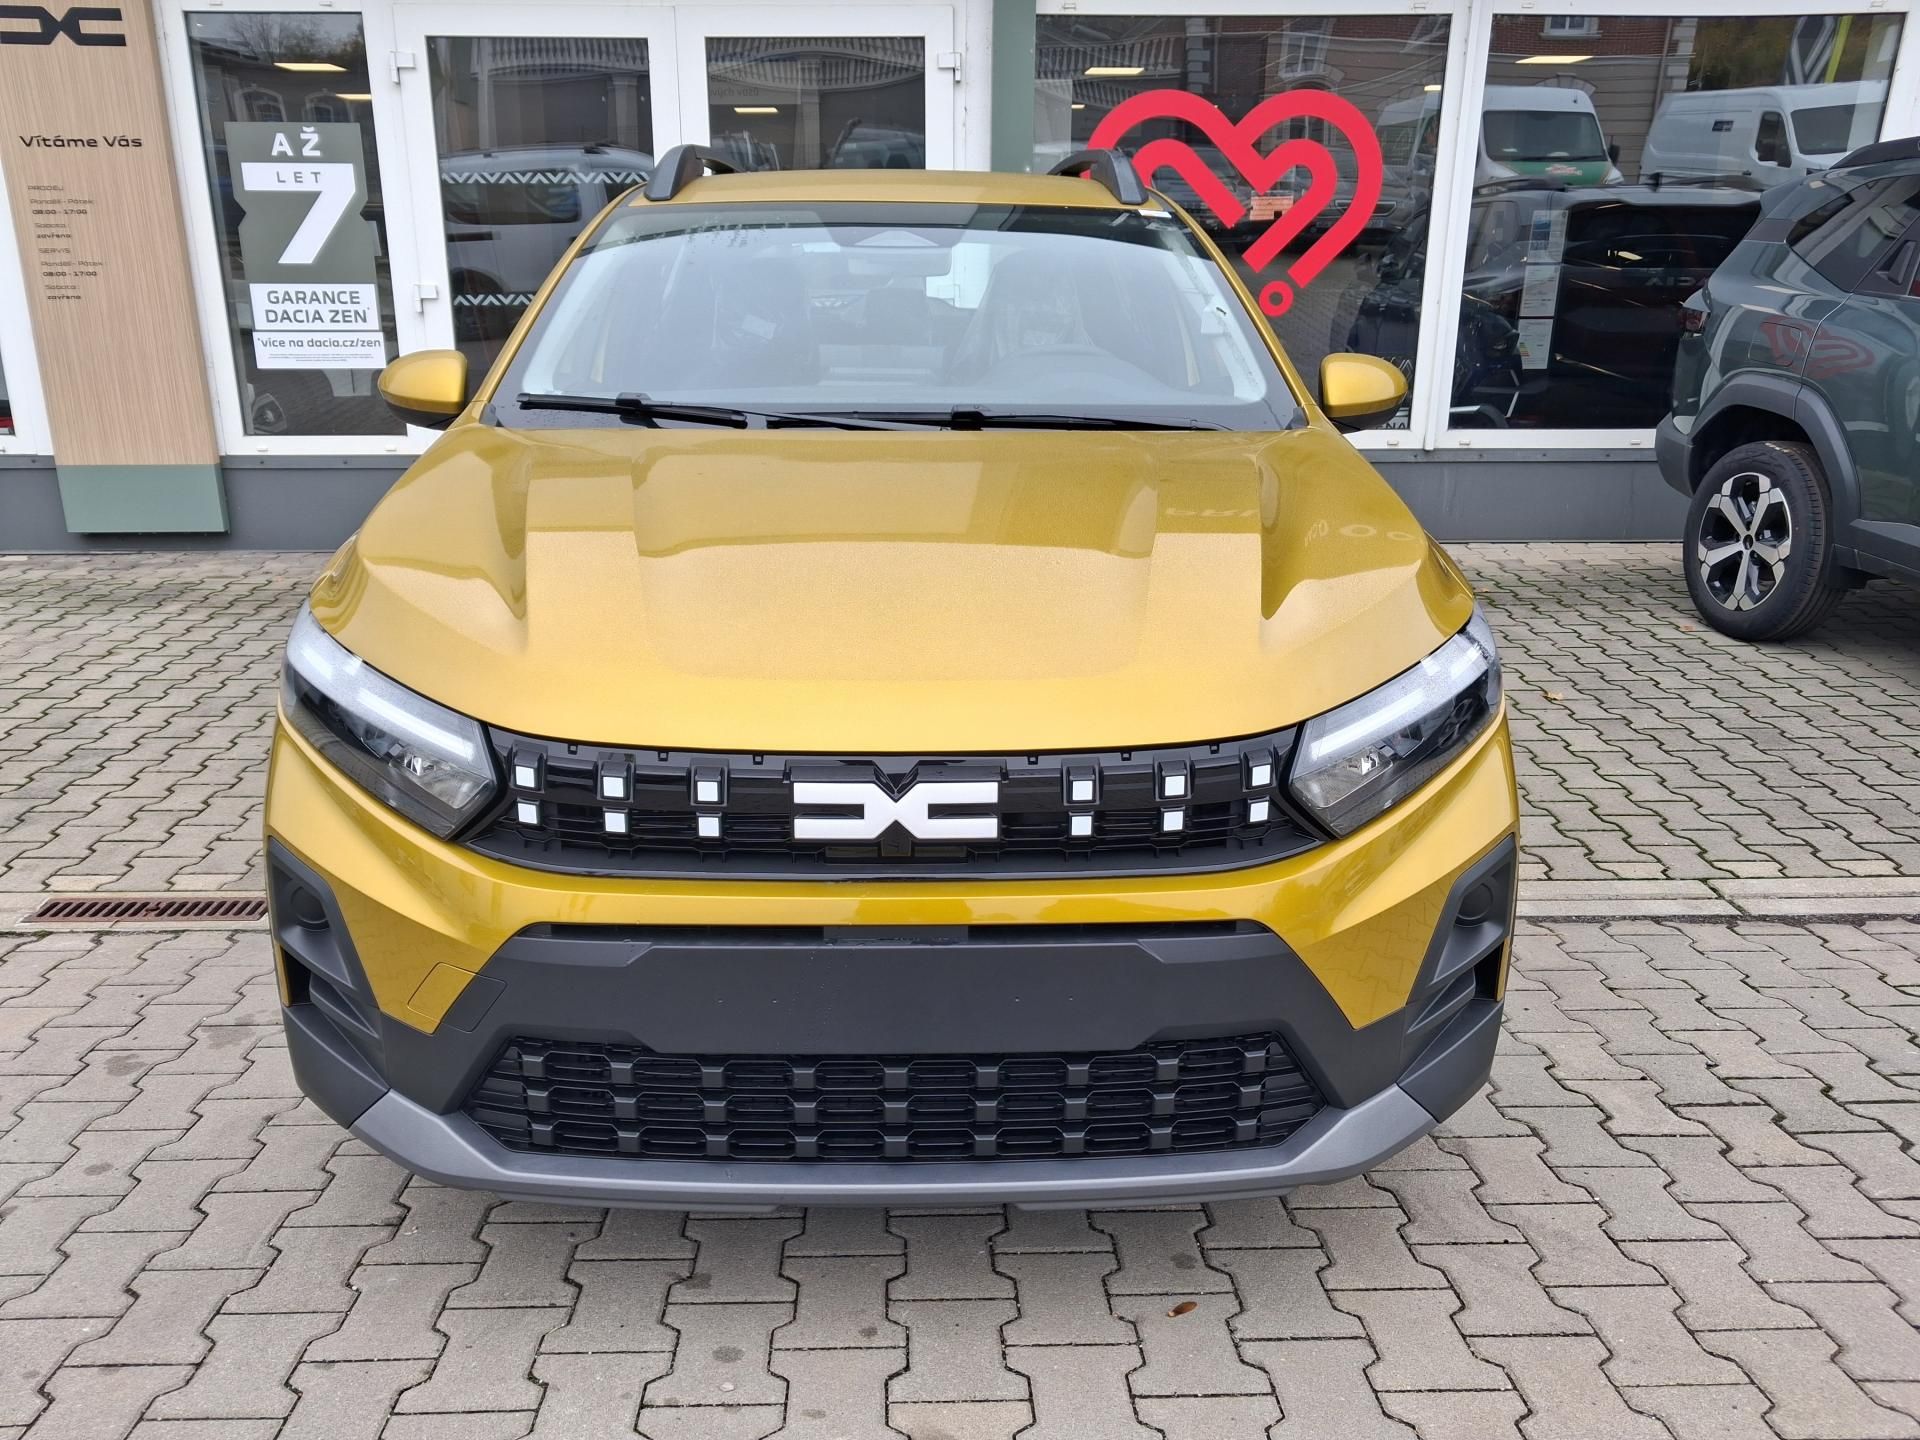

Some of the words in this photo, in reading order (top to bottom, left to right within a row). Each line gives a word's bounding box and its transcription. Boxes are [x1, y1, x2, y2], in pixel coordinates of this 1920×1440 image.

[19, 135, 98, 148] Vítáme
[102, 135, 143, 148] Vás
[271, 126, 321, 157] AŽ
[276, 170, 321, 184] LET
[241, 162, 356, 264] 7
[266, 290, 361, 305] GARANCE
[264, 309, 325, 323] DACIA
[288, 339, 304, 348] na
[306, 337, 381, 348] dacia.cz/zen
